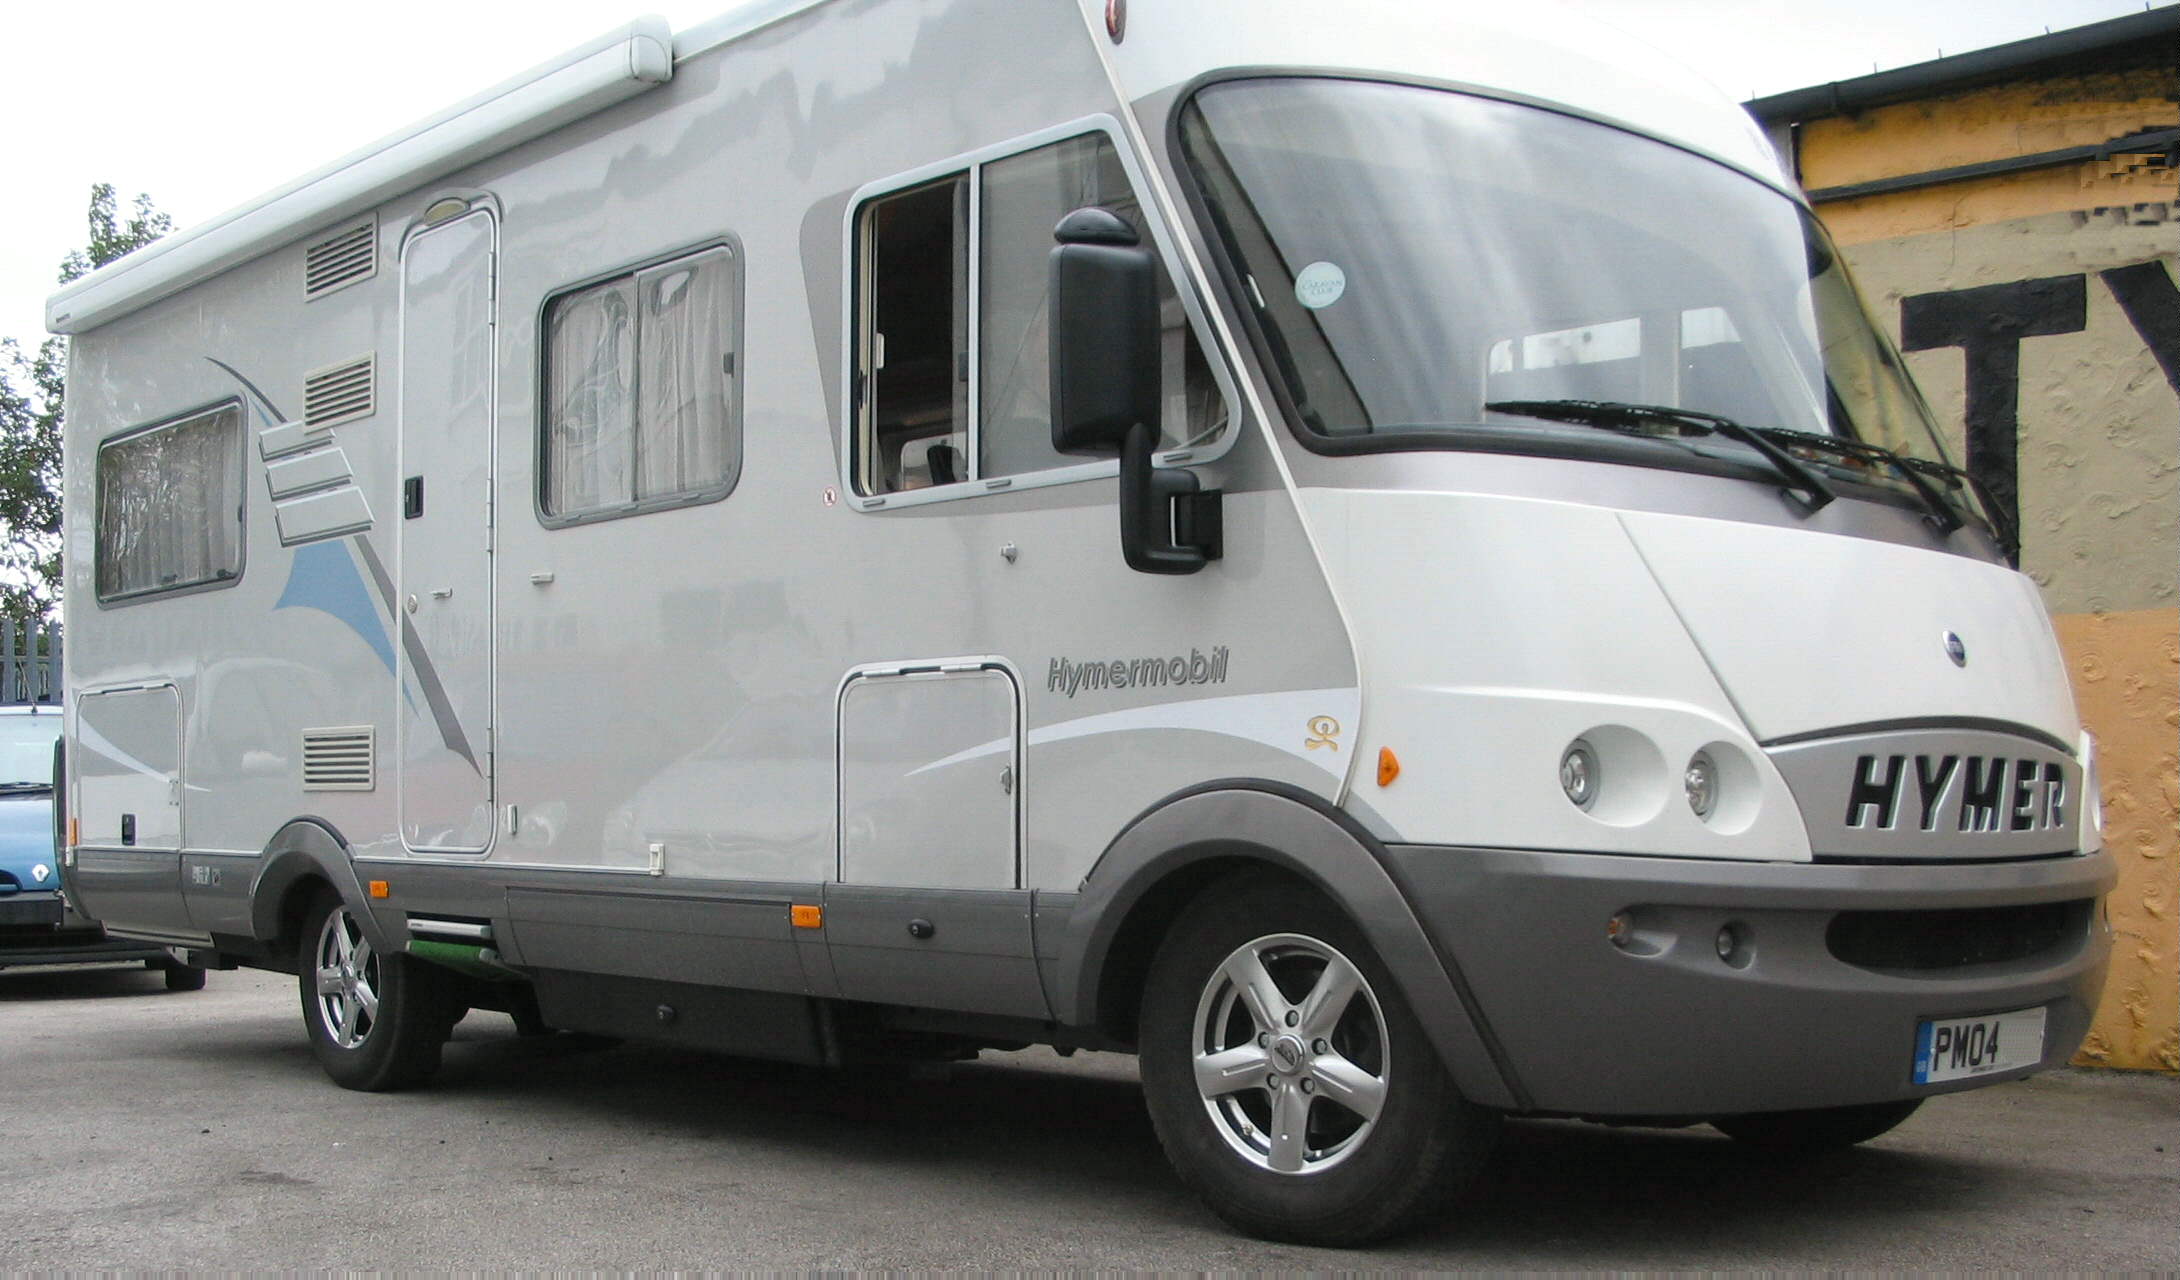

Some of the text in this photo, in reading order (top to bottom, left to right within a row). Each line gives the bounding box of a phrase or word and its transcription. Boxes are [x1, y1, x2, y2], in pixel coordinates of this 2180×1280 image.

[1048, 646, 1230, 698] Hymermobil
[1845, 754, 2066, 833] HYMER
[1932, 1020, 2000, 1072] PM04
